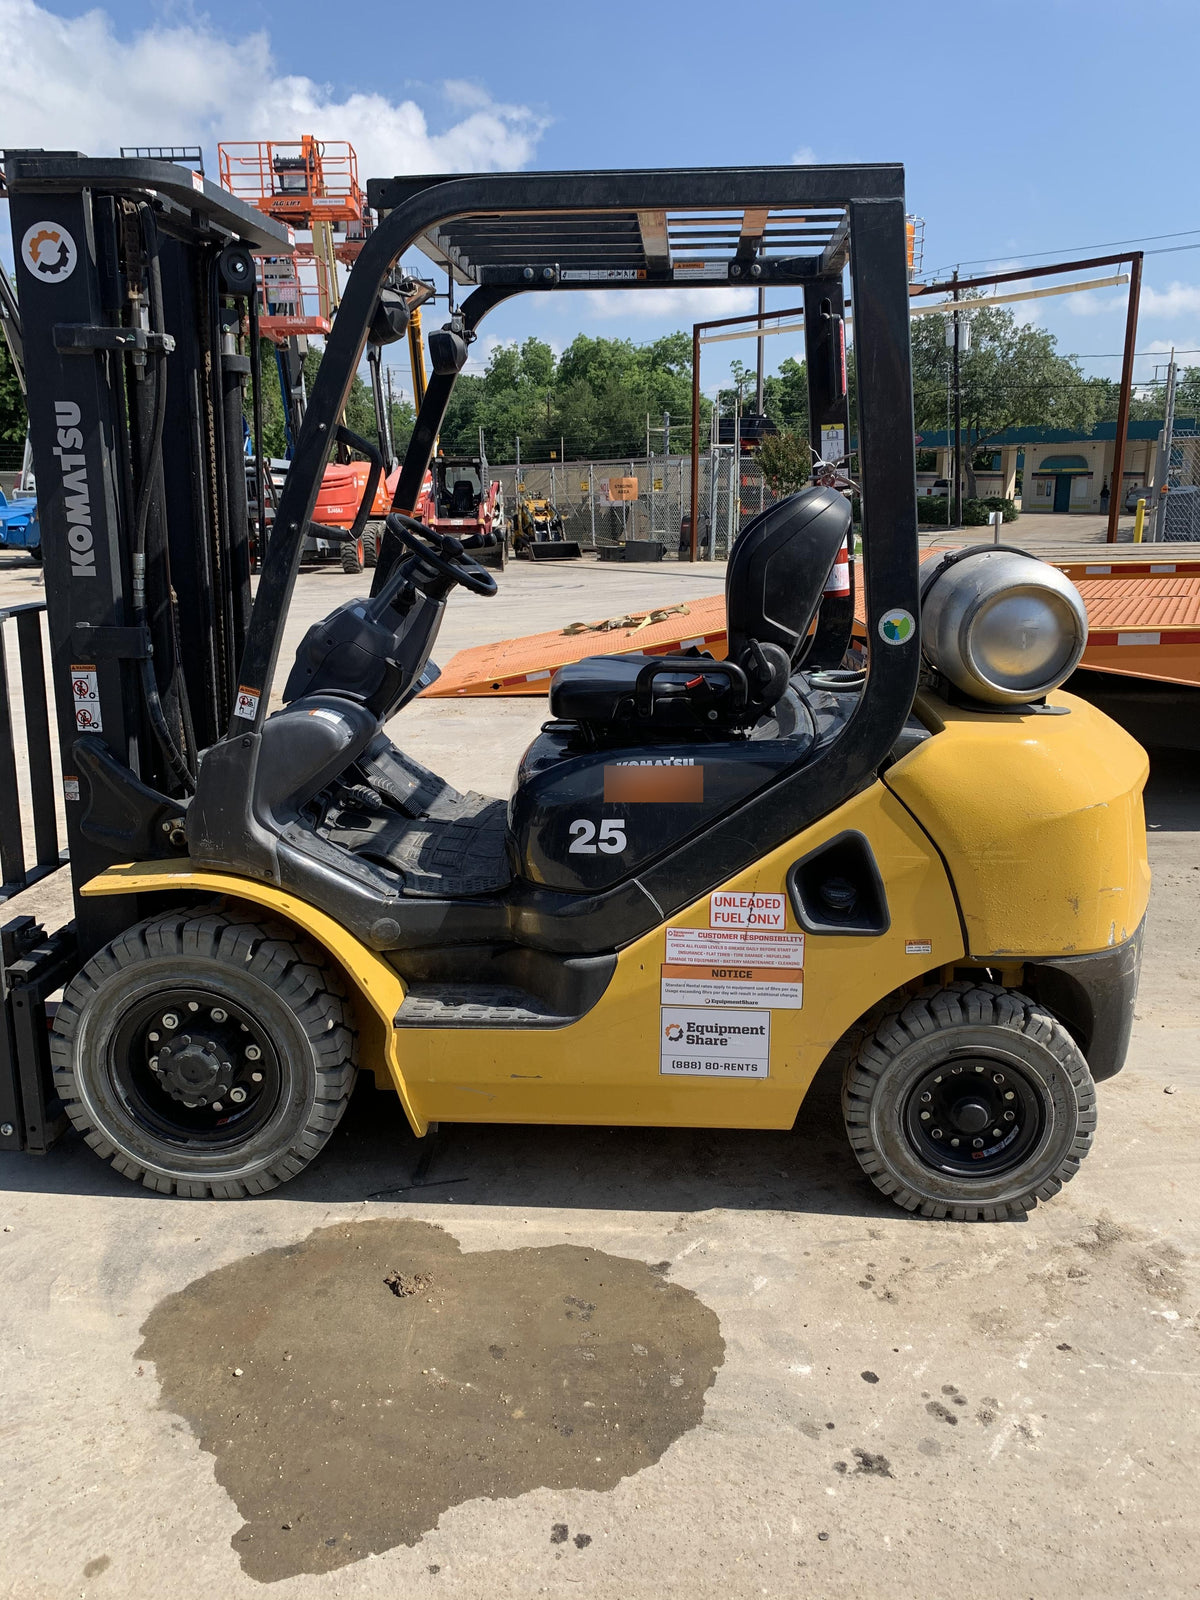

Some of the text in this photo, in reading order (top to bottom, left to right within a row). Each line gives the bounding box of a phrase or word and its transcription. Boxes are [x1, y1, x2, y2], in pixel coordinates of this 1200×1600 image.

[52, 400, 97, 577] KOMATSU
[568, 819, 627, 855] 25
[714, 896, 781, 909] UNLEADED
[714, 912, 780, 925] FUEL ONLY
[697, 932, 803, 943] CUSTOMER RESPONSIBILITY
[711, 969, 753, 979] NOTICE
[686, 1022, 765, 1036] Equipment
[686, 1034, 728, 1046] Share
[672, 1060, 758, 1072] (888) 80-RENTS
